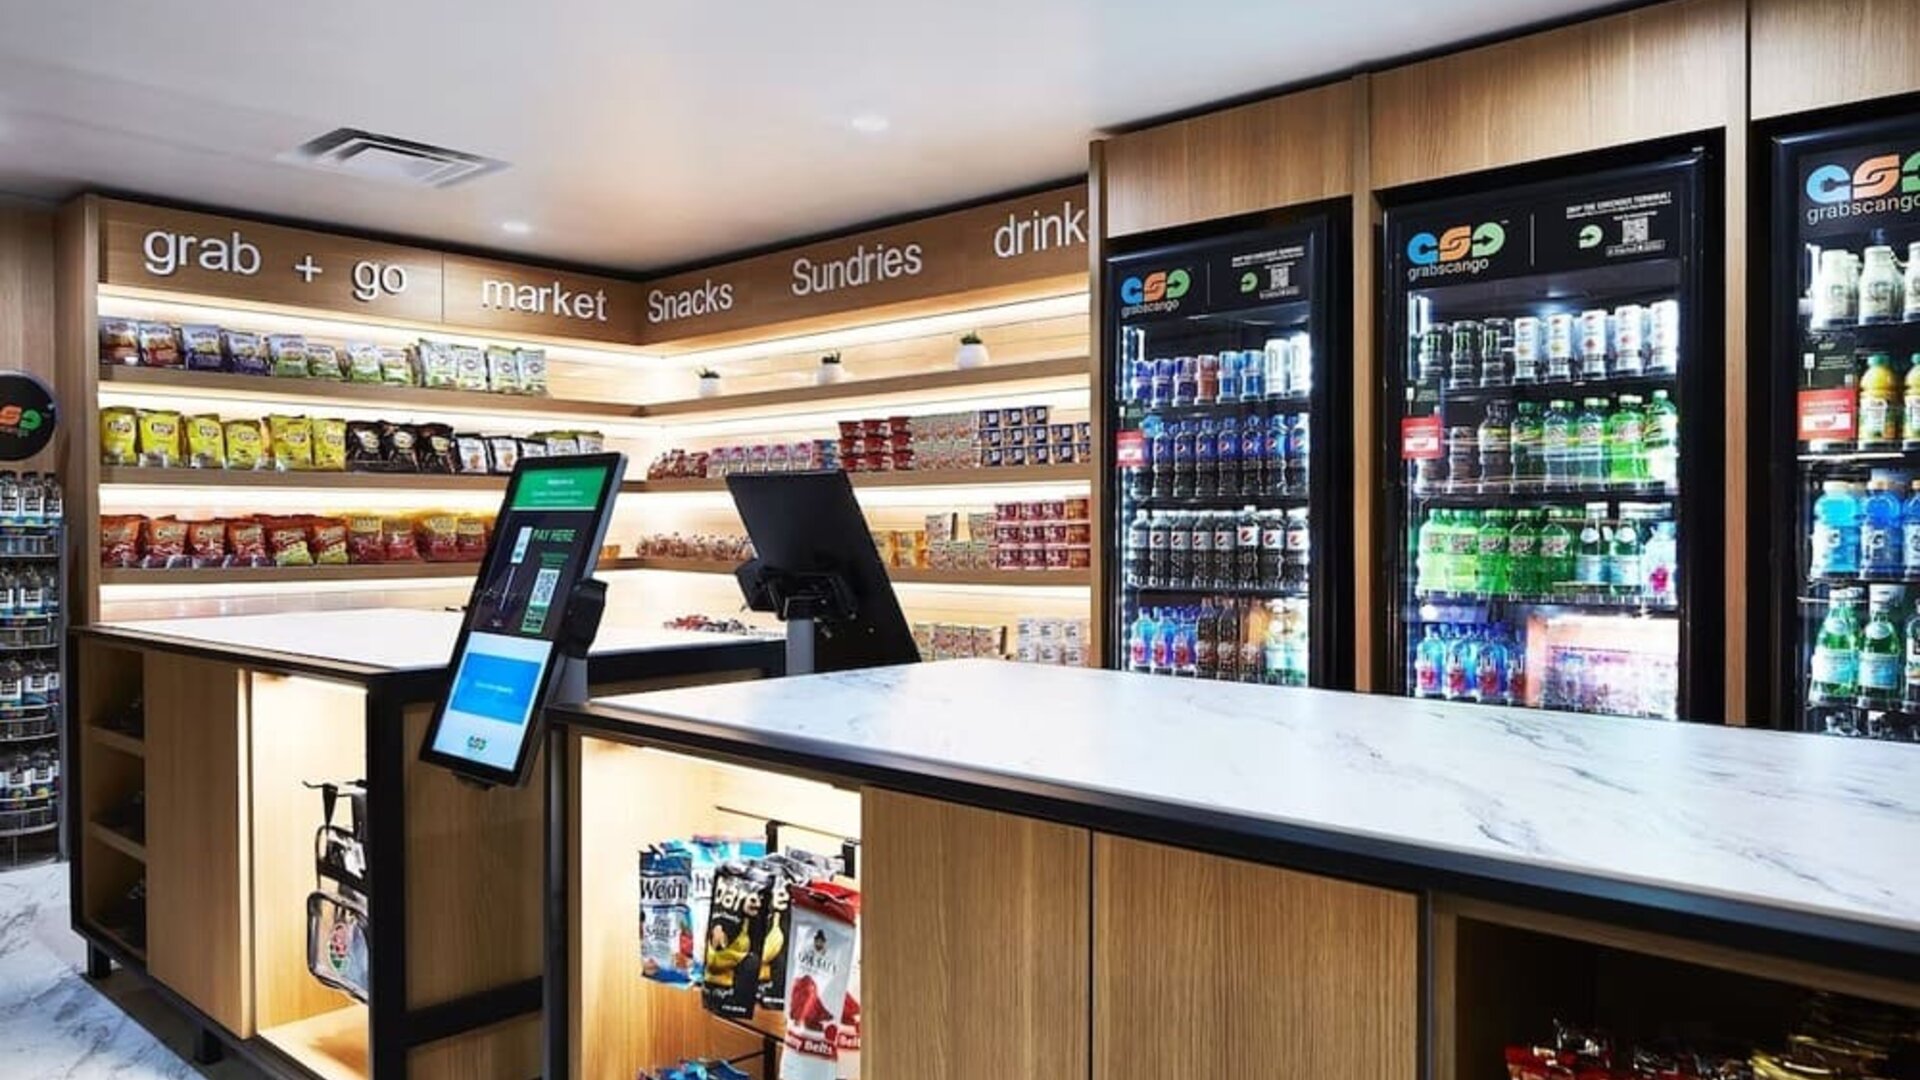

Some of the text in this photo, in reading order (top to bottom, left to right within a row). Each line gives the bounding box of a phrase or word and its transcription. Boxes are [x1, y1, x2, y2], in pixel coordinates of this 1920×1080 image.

[994, 202, 1087, 258] drink
[143, 229, 262, 278] grab
[352, 261, 408, 304] go
[791, 241, 923, 297] Sundries
[1407, 257, 1489, 281] grabscango
[481, 277, 607, 322] market
[647, 280, 734, 323] Snacks
[532, 529, 576, 542] PAY HERE
[714, 876, 761, 916] bare
